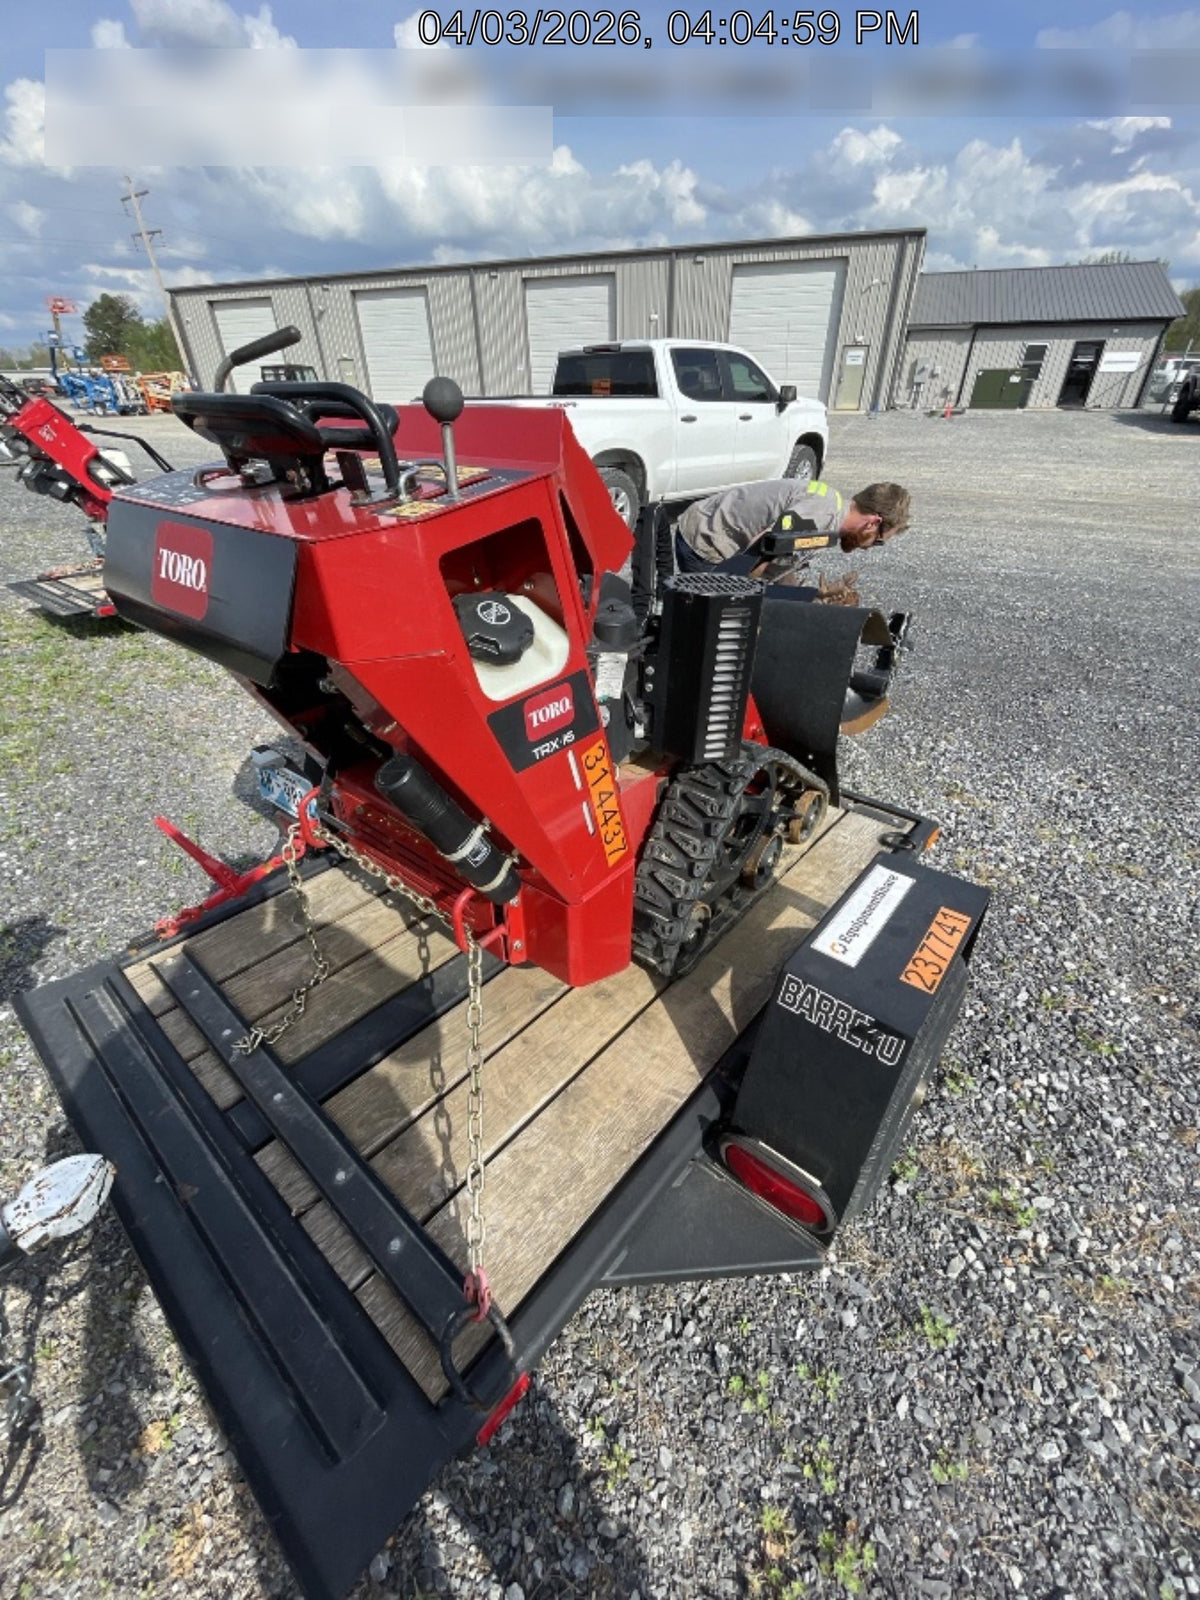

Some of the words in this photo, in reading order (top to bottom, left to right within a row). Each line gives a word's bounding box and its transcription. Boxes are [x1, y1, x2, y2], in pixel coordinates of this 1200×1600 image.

[158, 547, 206, 592] TORO
[527, 696, 571, 728] TORO
[585, 745, 627, 857] 314437
[838, 874, 899, 944] EquipmentShare
[904, 911, 968, 991] 237741
